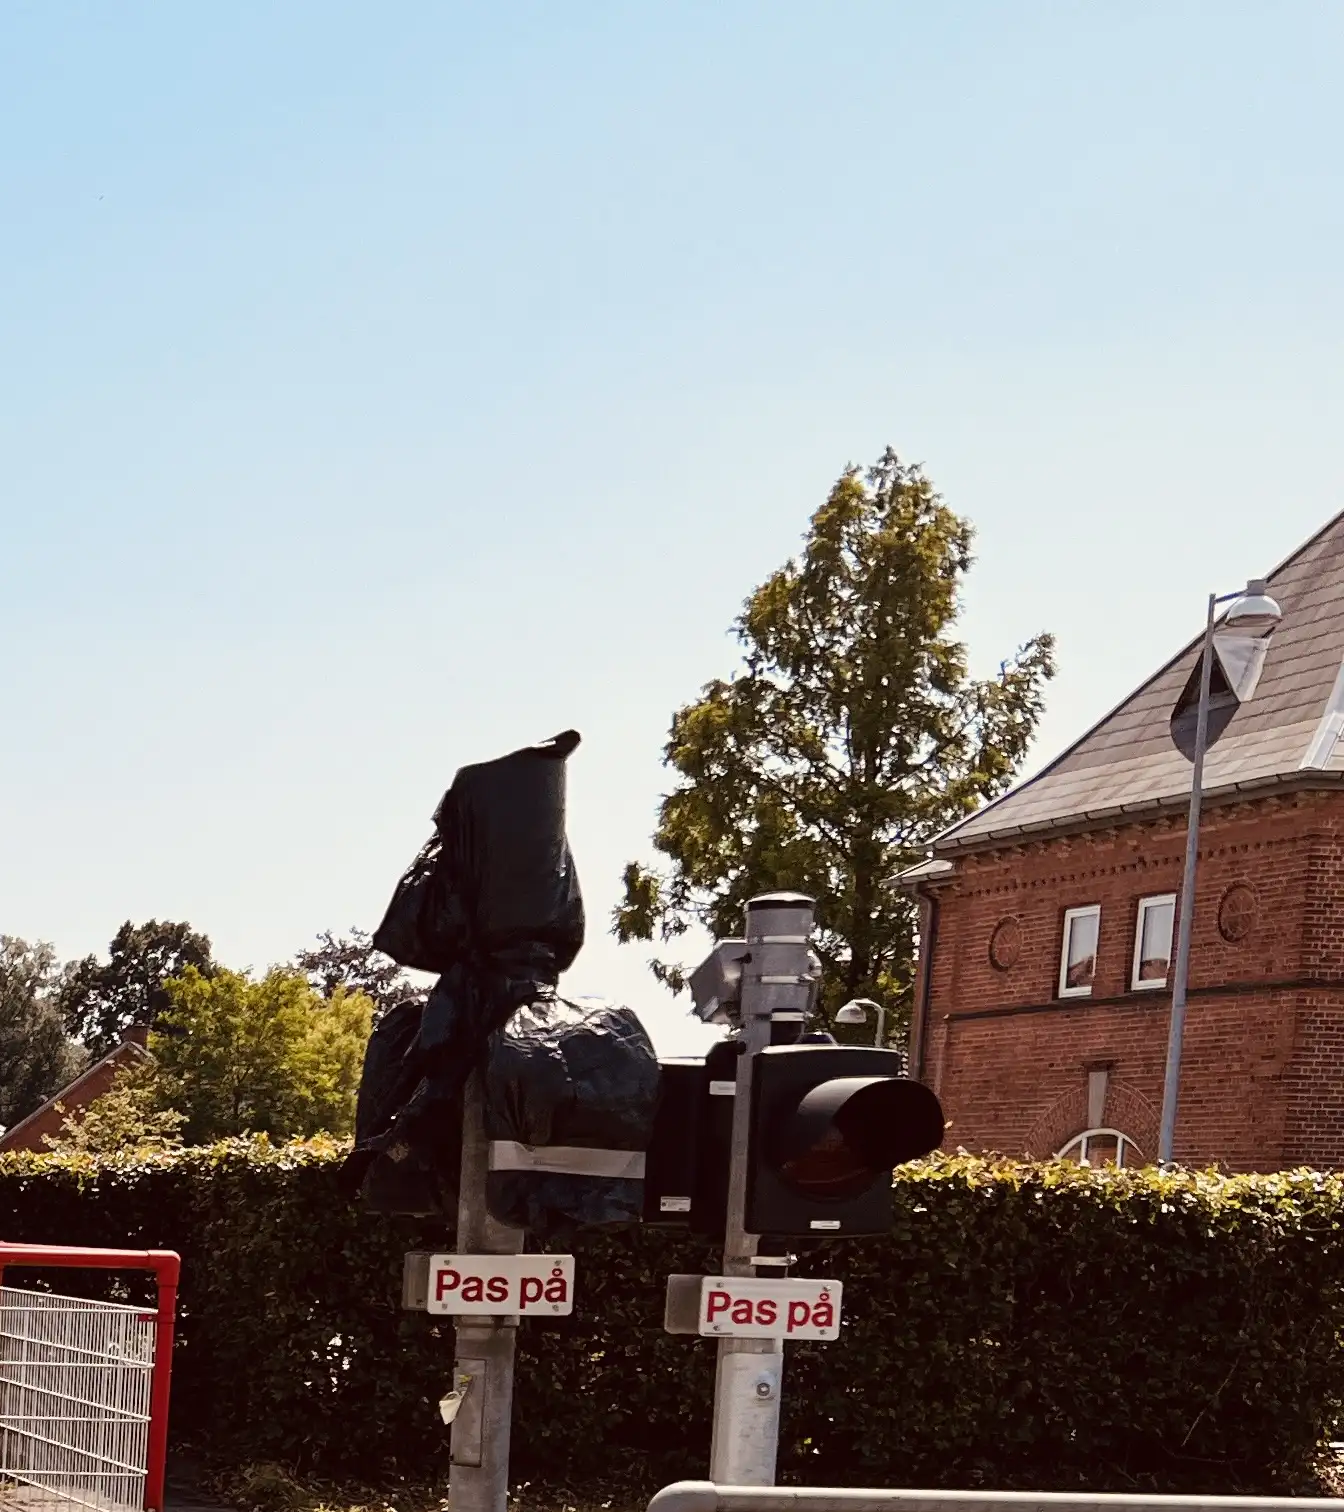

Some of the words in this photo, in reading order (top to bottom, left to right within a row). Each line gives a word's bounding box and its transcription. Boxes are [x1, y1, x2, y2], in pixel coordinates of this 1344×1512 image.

[435, 1269, 509, 1303] Pas
[519, 1267, 568, 1310] på
[706, 1291, 778, 1326] Pas
[786, 1292, 834, 1333] på
